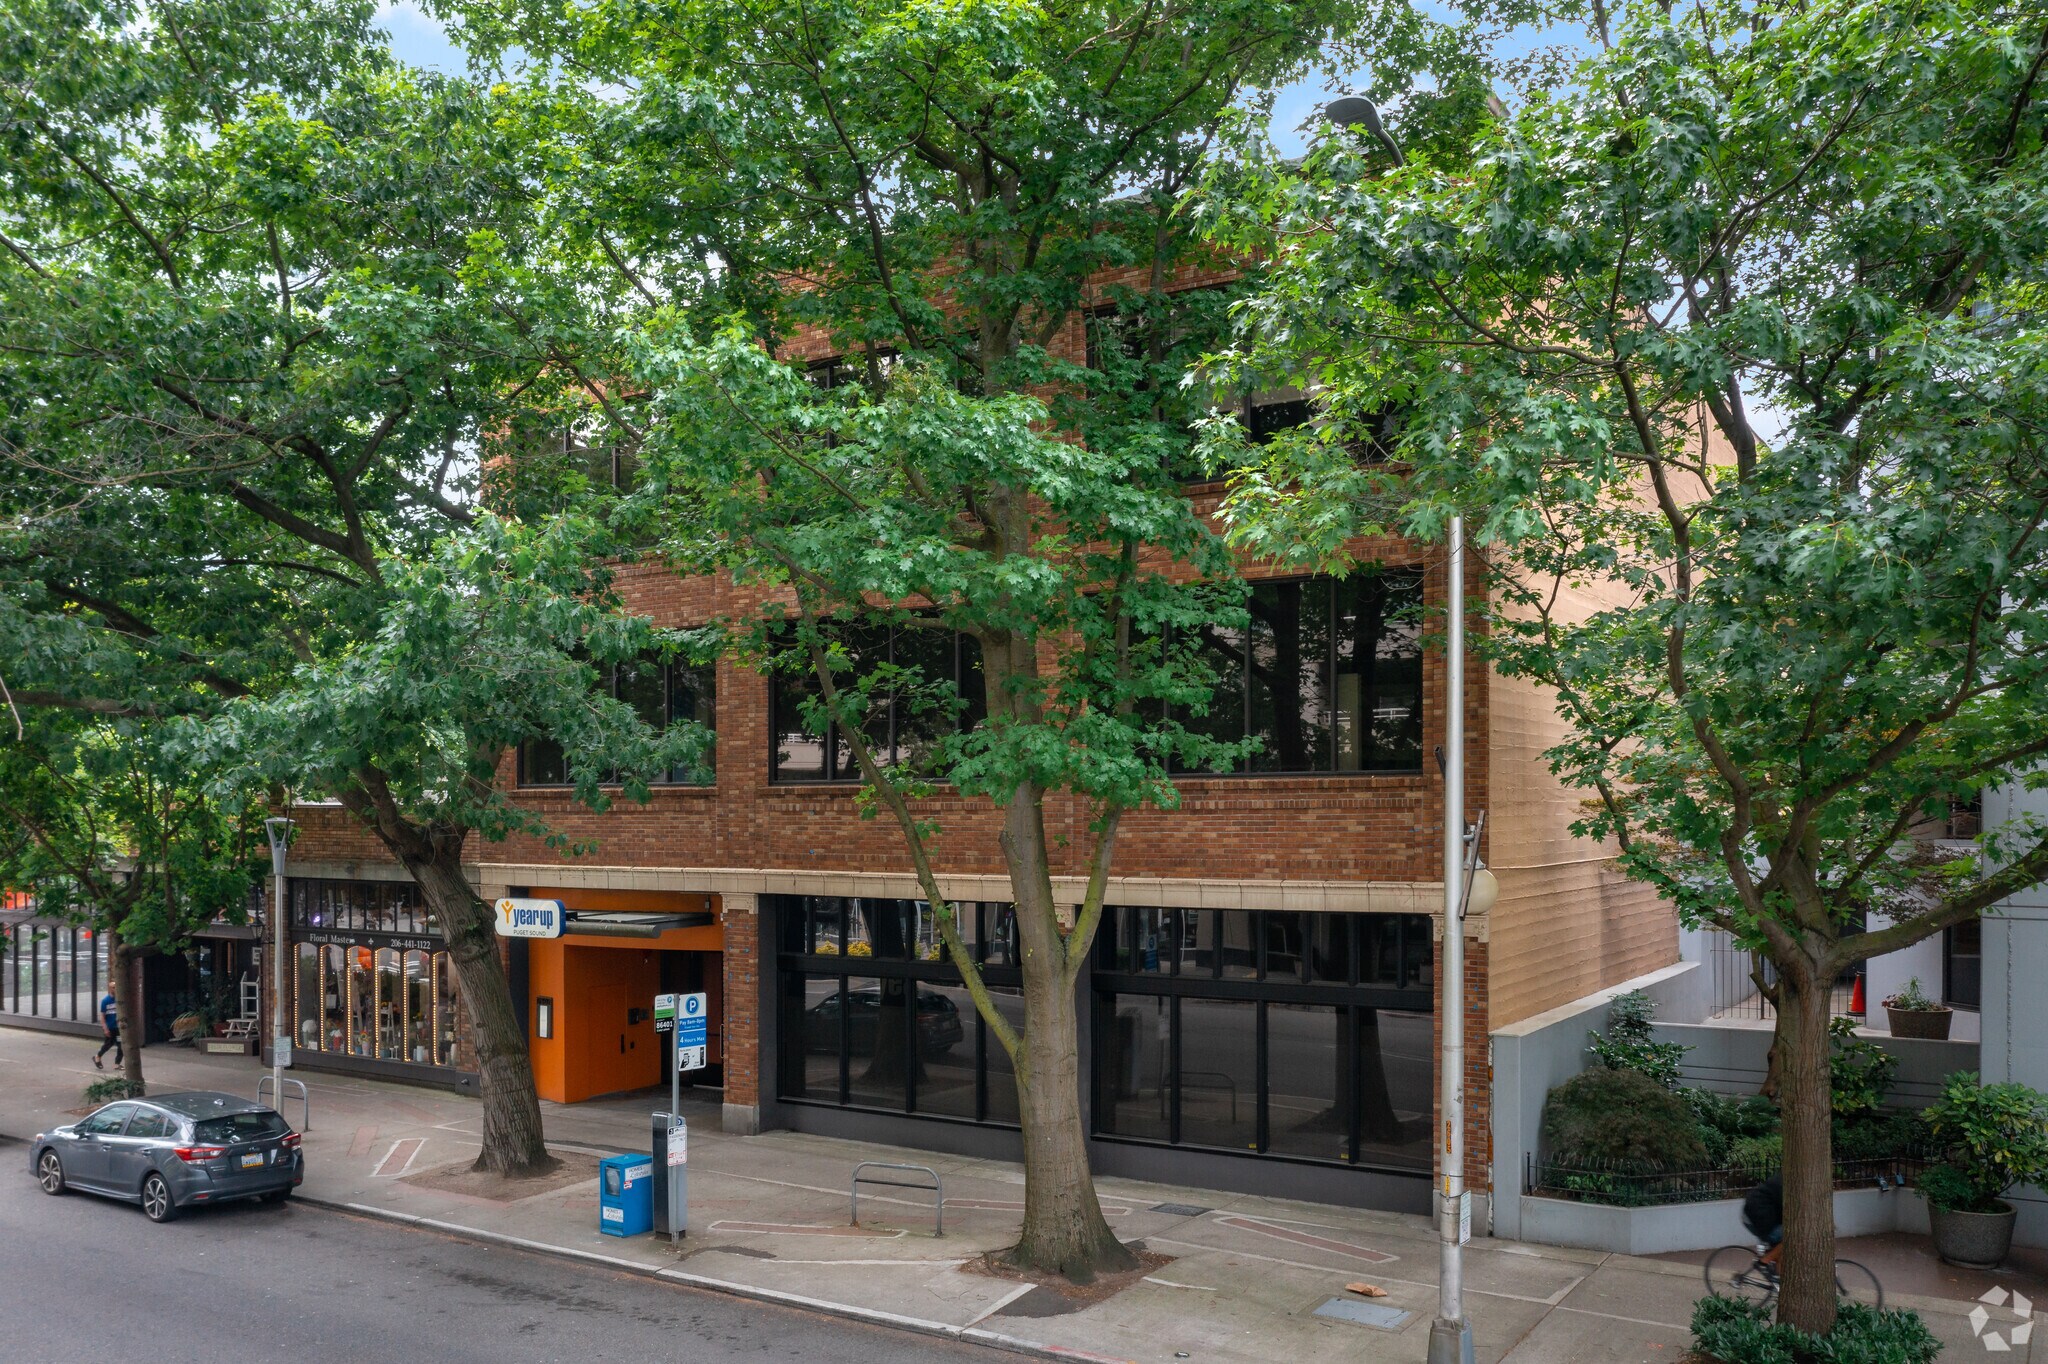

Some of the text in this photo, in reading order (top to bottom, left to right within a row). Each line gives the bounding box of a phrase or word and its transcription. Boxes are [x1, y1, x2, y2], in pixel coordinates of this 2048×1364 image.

[310, 933, 355, 945] Floral Maste
[391, 939, 431, 949] 206-441-1122
